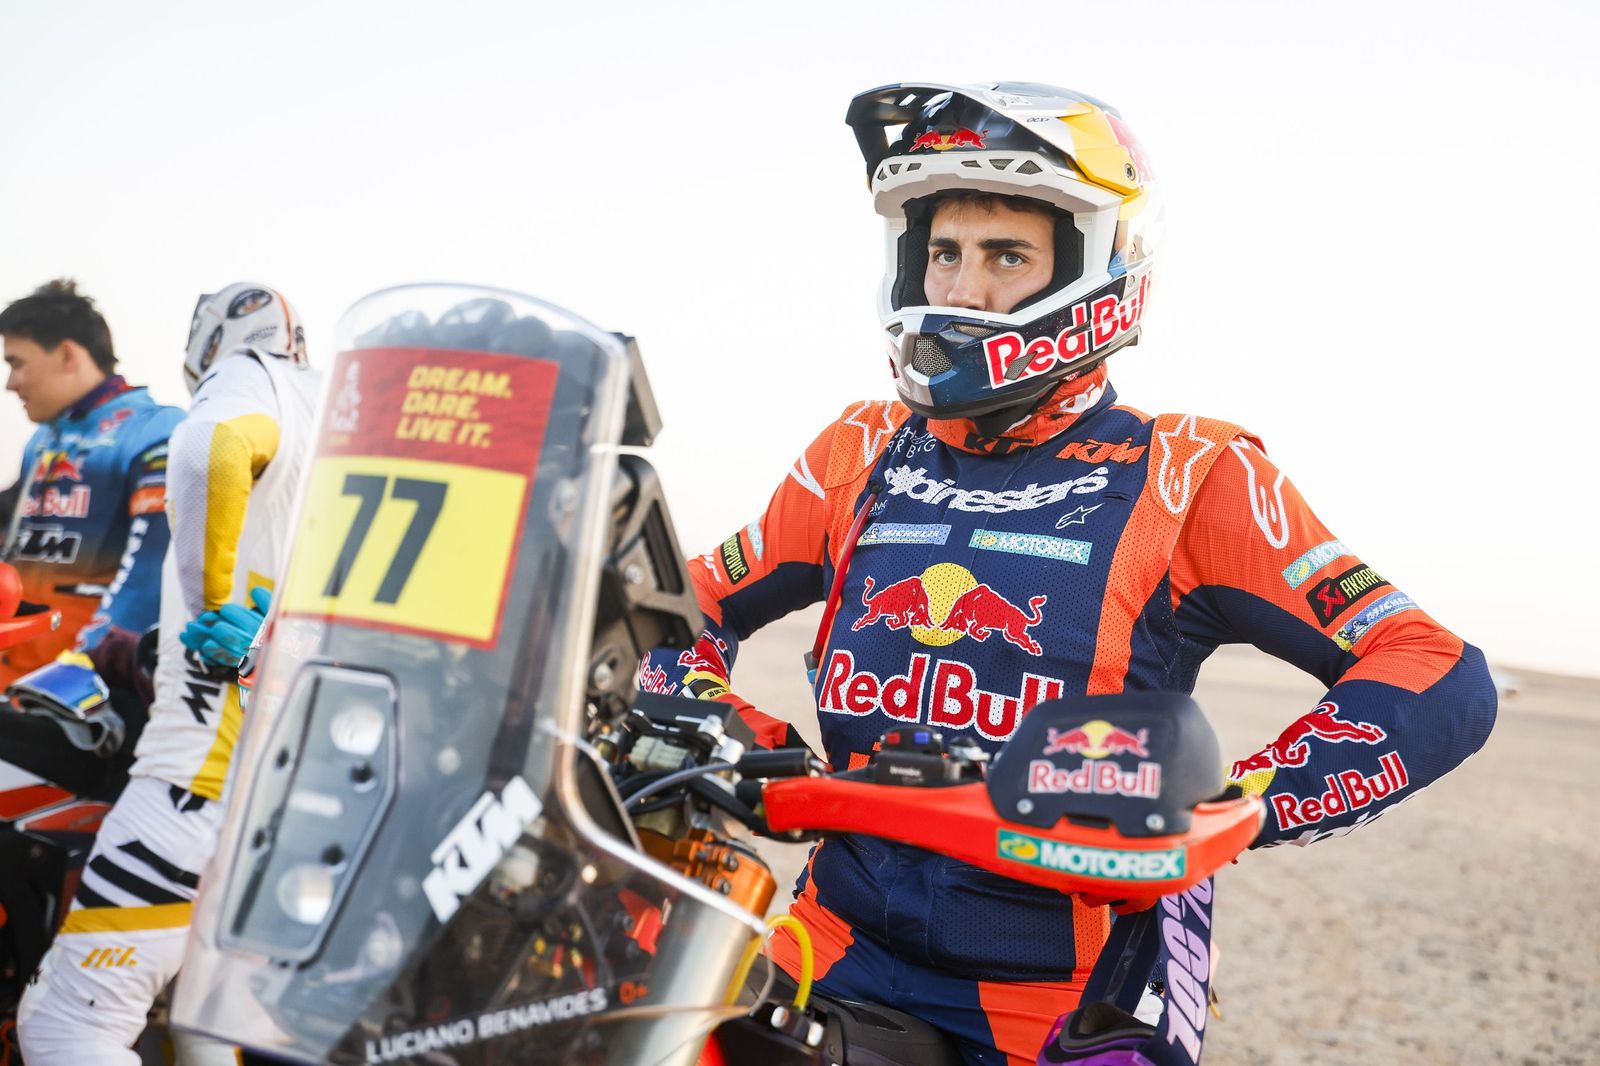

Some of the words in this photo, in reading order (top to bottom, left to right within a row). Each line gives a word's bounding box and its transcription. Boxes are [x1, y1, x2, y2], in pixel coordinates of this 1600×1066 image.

[982, 300, 1089, 390] Red
[402, 391, 482, 420] DARE.
[407, 366, 514, 399] DREAM.
[395, 416, 453, 442] LIVE
[456, 420, 494, 449] IT.
[1055, 437, 1148, 465] KTM
[883, 464, 1109, 514] pinestars
[320, 473, 450, 607] 77
[998, 538, 1083, 561] MOTOREX
[819, 649, 930, 724] Red
[1027, 759, 1093, 795] Red
[1092, 762, 1162, 799] Bull
[1271, 774, 1348, 832] Red
[1337, 750, 1410, 811] Bull
[422, 775, 544, 925] KTM
[1041, 841, 1182, 880] MOTOREX
[1160, 876, 1213, 1065] 100%
[365, 1018, 476, 1065] LUCIANO
[477, 987, 608, 1039] BENAVIDES
